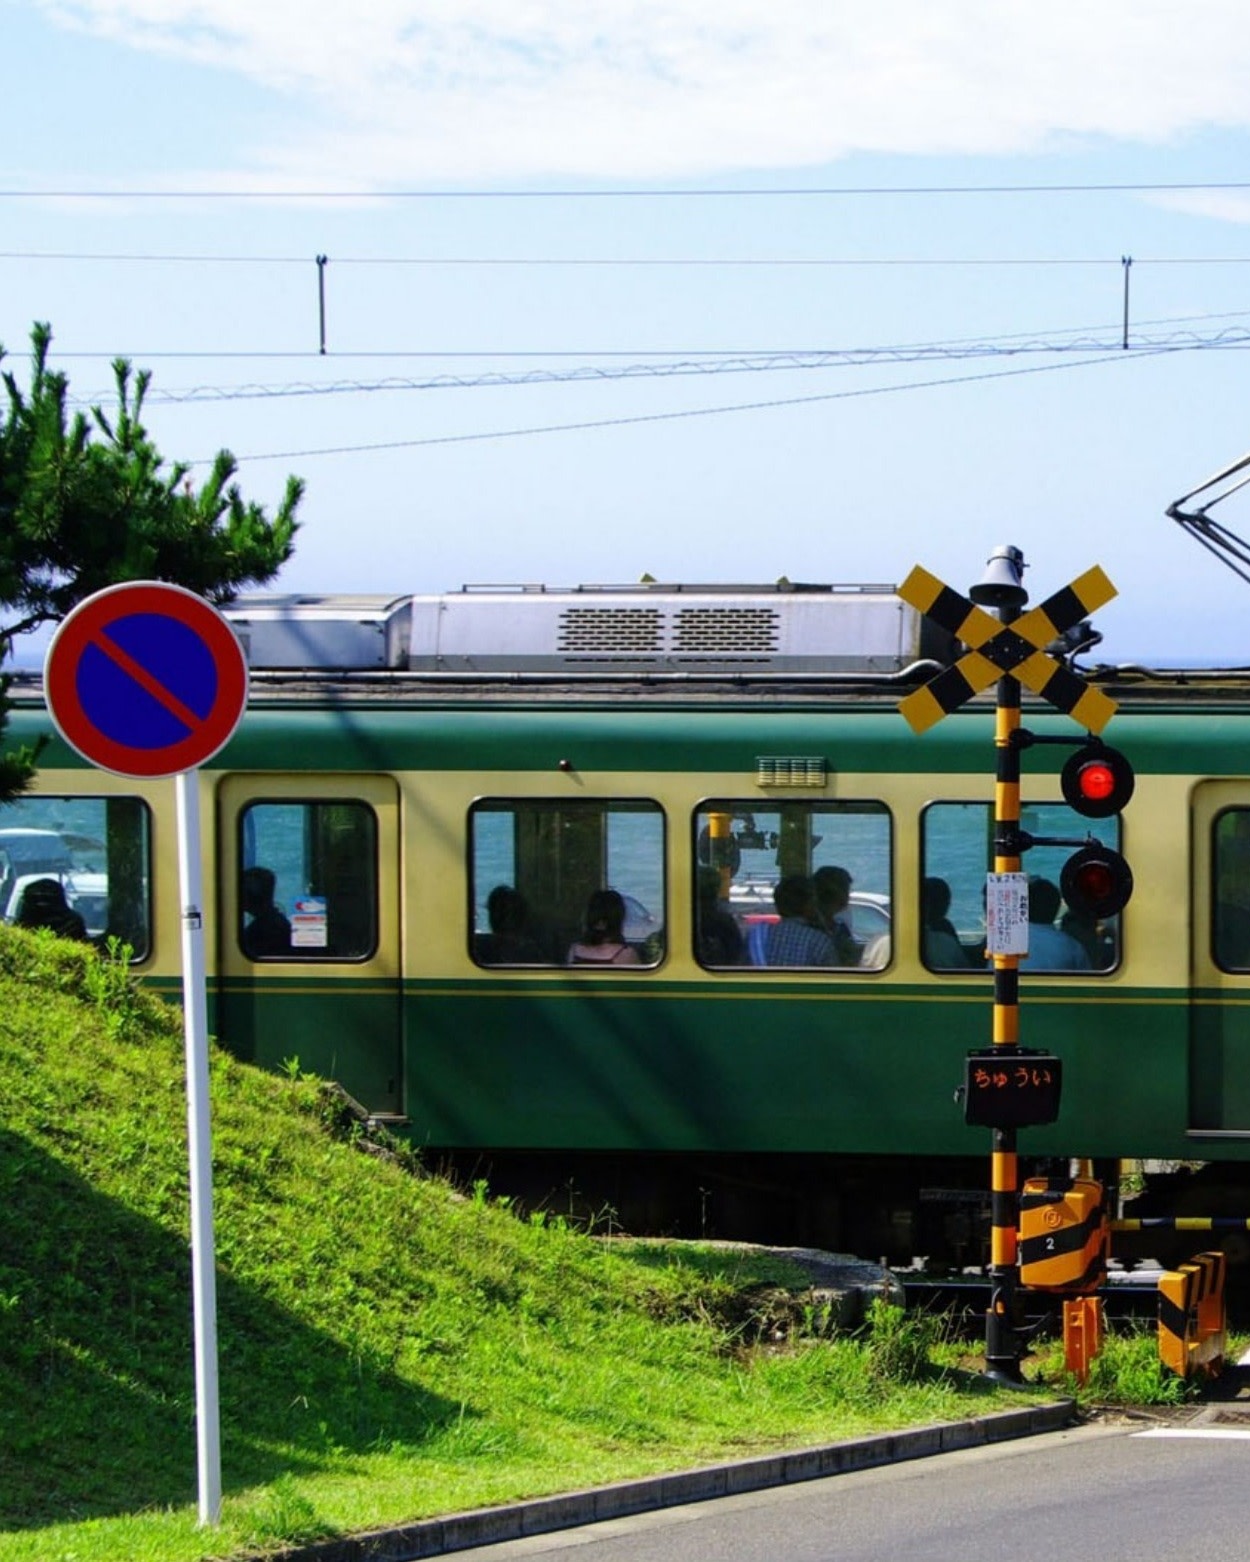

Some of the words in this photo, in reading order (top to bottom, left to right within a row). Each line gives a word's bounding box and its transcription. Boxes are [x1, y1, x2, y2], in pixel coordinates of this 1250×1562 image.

[974, 1067, 1051, 1087] ちゅうい
[1045, 1237, 1055, 1250] 2
